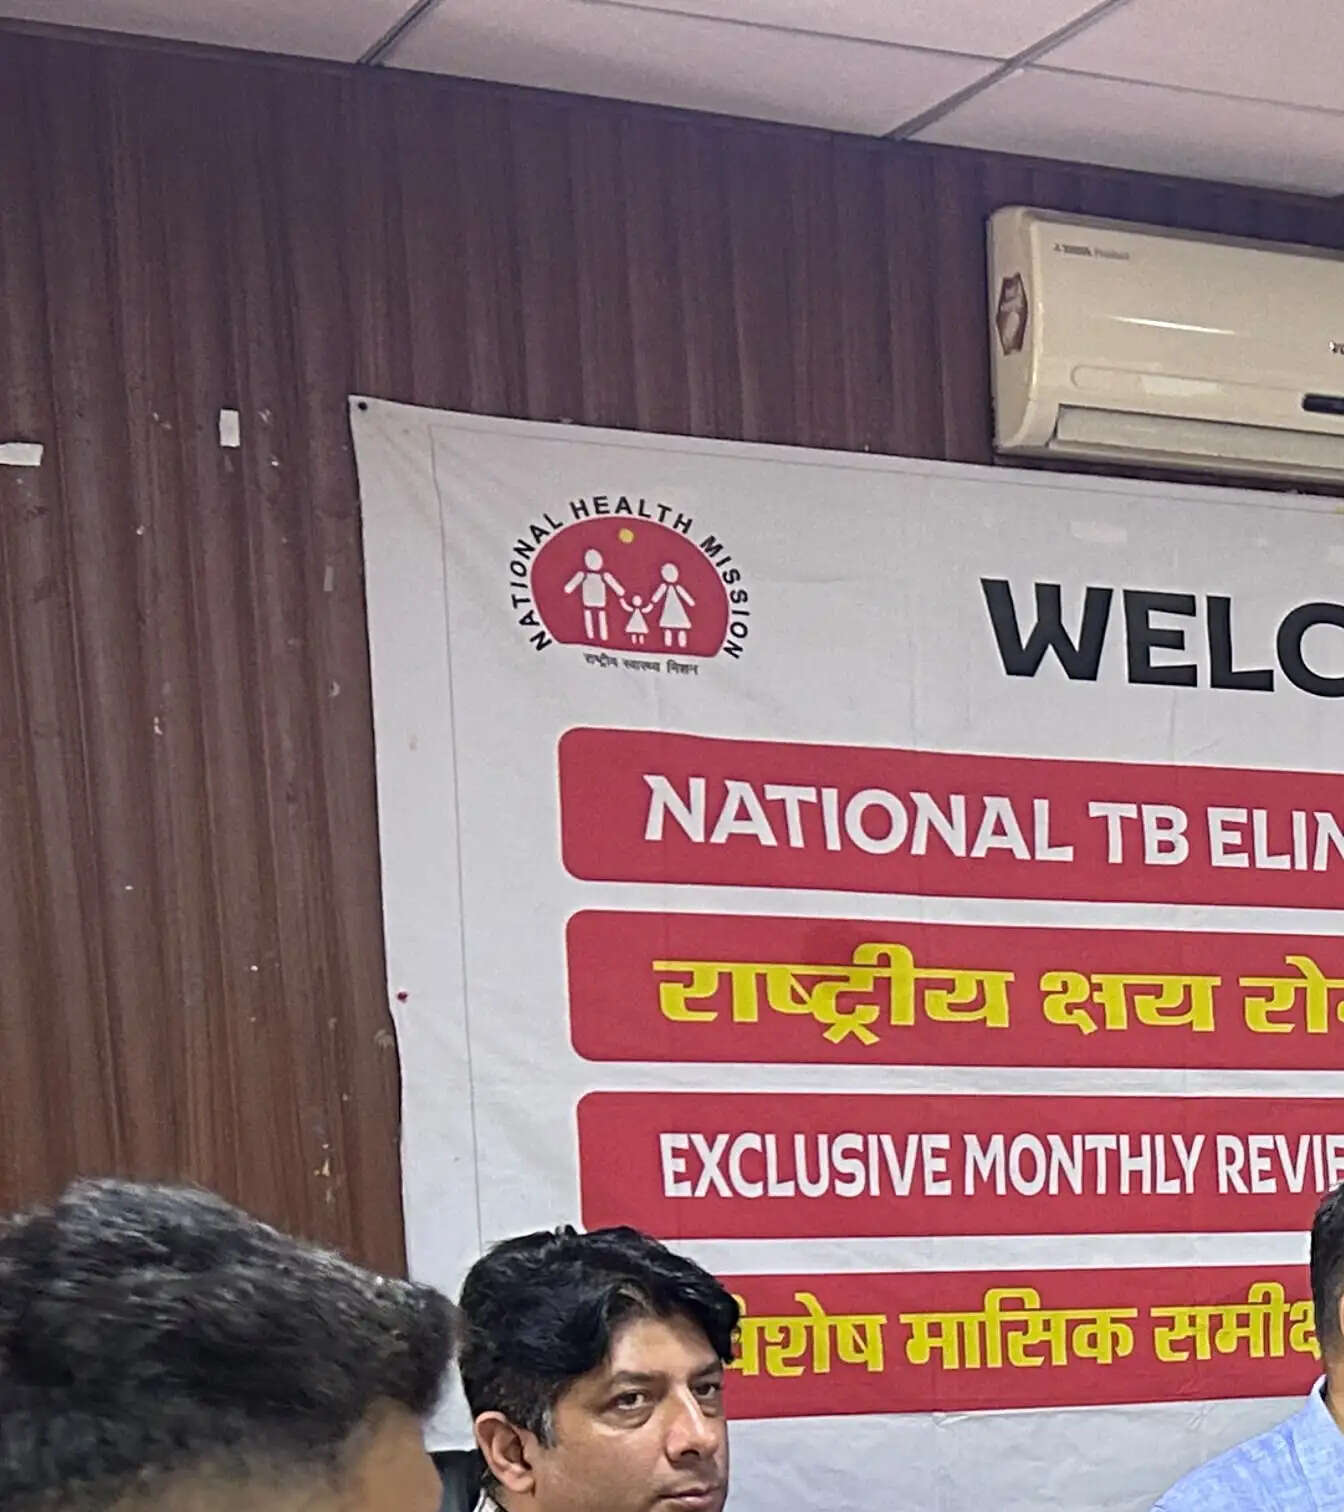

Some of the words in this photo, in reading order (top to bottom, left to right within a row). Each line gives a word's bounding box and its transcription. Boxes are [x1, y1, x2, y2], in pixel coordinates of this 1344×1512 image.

[510, 513, 564, 651] NATIONAL
[569, 496, 693, 534] HEALTH
[700, 535, 750, 659] MISSION
[643, 774, 1074, 863] NATIONAL
[1089, 801, 1190, 865] TB
[652, 943, 1015, 1046] राष्ट्रीय
[1039, 970, 1222, 1036] क्षय
[659, 1132, 950, 1198] EXCLUSIVE
[964, 1133, 1206, 1196] MONTHLY
[899, 1287, 1138, 1371] मासिक
